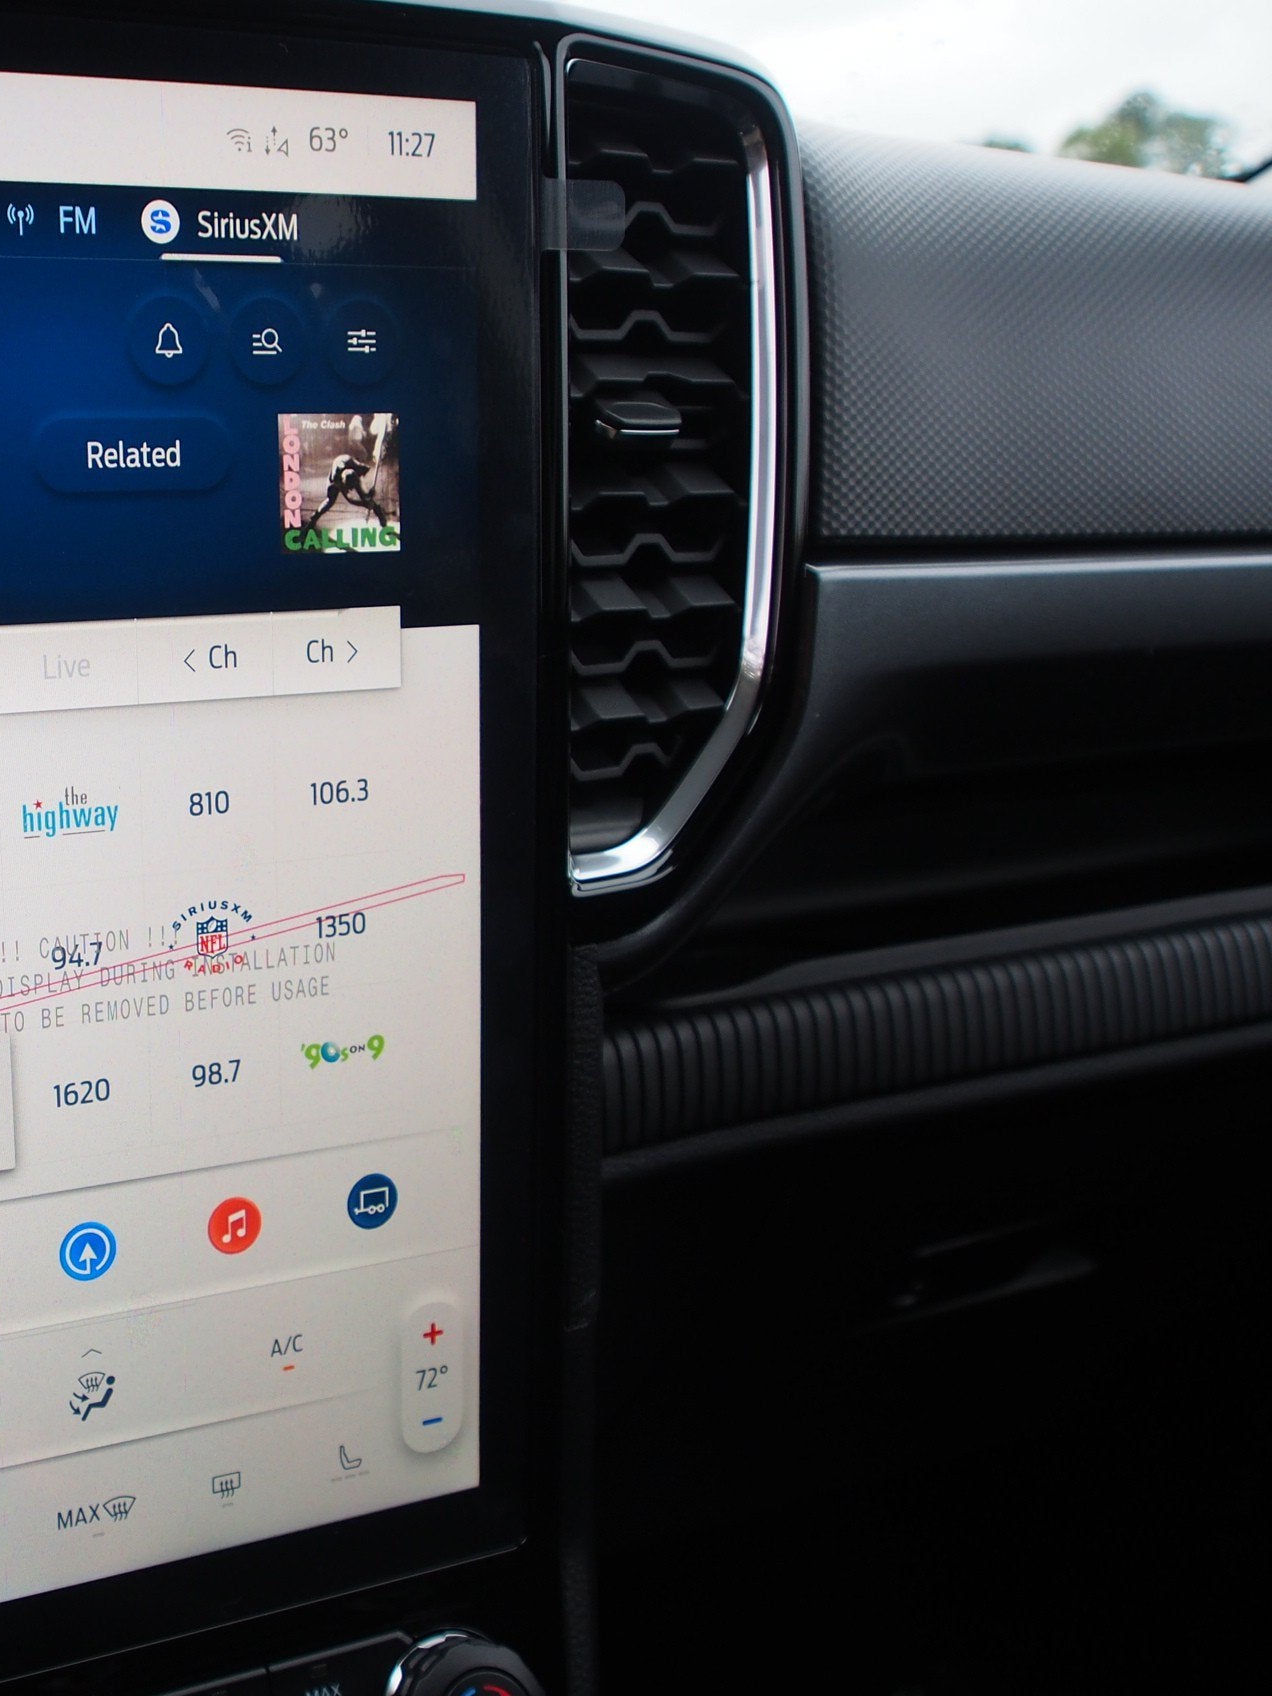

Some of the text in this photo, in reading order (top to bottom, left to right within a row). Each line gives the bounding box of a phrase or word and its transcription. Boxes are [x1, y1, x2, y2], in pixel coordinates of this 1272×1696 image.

[387, 131, 436, 158] 11:27
[59, 206, 96, 235] FM
[197, 210, 298, 242] SiriusXM
[301, 420, 346, 430] The Clash
[86, 440, 181, 469] Related
[283, 414, 302, 529] LONDON
[284, 526, 397, 551] CALLING
[208, 643, 238, 670] Ch
[306, 638, 334, 664] Ch
[42, 653, 91, 680] Live
[64, 786, 88, 806] the
[189, 790, 230, 817] 810
[310, 778, 369, 806] 106.3
[22, 801, 119, 837] highway
[172, 900, 253, 931] SIRIUSXM
[315, 911, 366, 939] 1350
[39, 929, 129, 959] CAUTION
[51, 941, 103, 970] 94.7
[200, 934, 226, 954] NFL
[100, 959, 175, 987] DURING
[192, 942, 335, 977] INSTALLATION
[184, 955, 244, 974] RADIO
[0, 1011, 25, 1033] TO
[42, 1006, 64, 1029] BE
[82, 994, 169, 1024] REMOVED
[185, 984, 257, 1012] BEFORE
[272, 976, 330, 1001] USAGE
[367, 1034, 385, 1060] 9
[192, 1059, 242, 1087] 98.7
[53, 1078, 111, 1108] 1620
[270, 1334, 304, 1358] A/C
[56, 1503, 102, 1531] MAX
